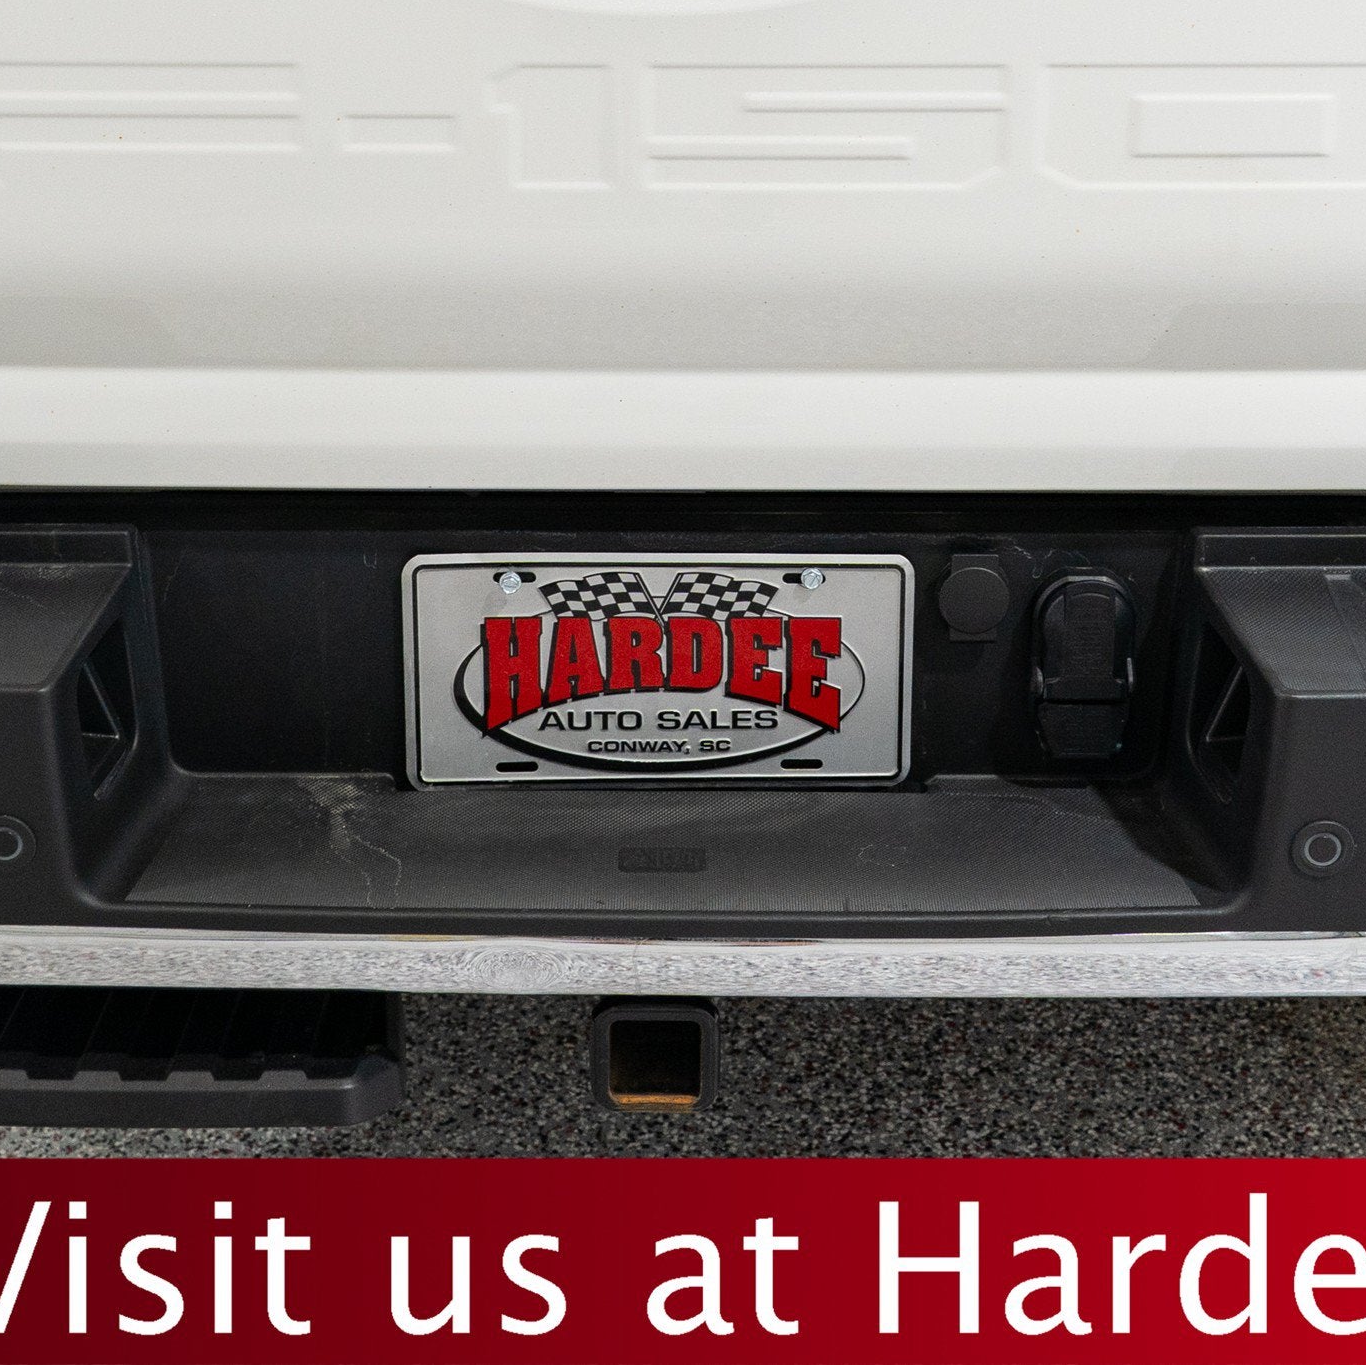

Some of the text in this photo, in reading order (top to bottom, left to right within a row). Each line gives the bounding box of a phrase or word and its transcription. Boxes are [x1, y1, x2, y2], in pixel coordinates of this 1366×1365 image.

[481, 616, 842, 735] HARDEE
[537, 708, 779, 732] AUTO SALES
[587, 738, 732, 755] CONWAY, SC
